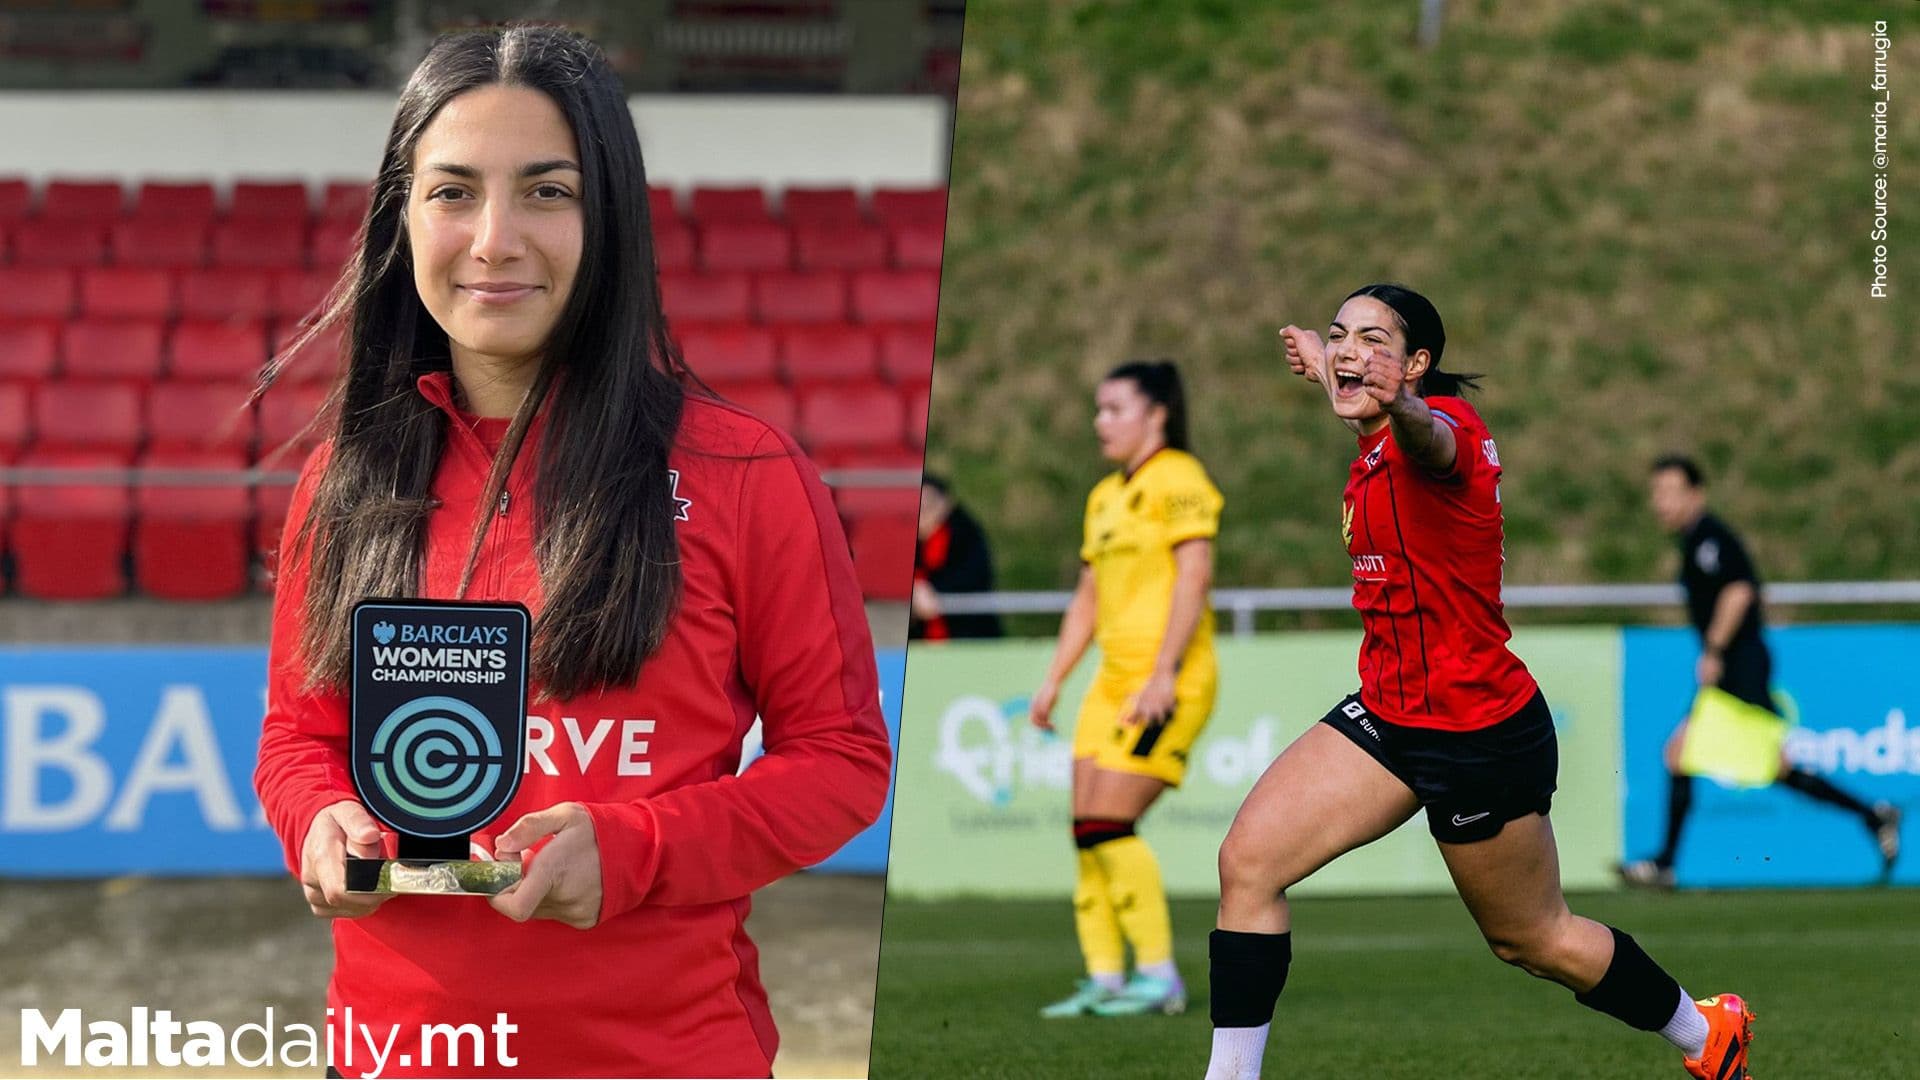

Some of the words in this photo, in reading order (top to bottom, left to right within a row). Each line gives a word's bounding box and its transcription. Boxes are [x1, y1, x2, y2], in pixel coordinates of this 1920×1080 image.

[401, 624, 508, 645] BARCLAYS
[372, 647, 507, 670] WOMEN'S
[371, 668, 506, 684] CHAMPIONSHIP
